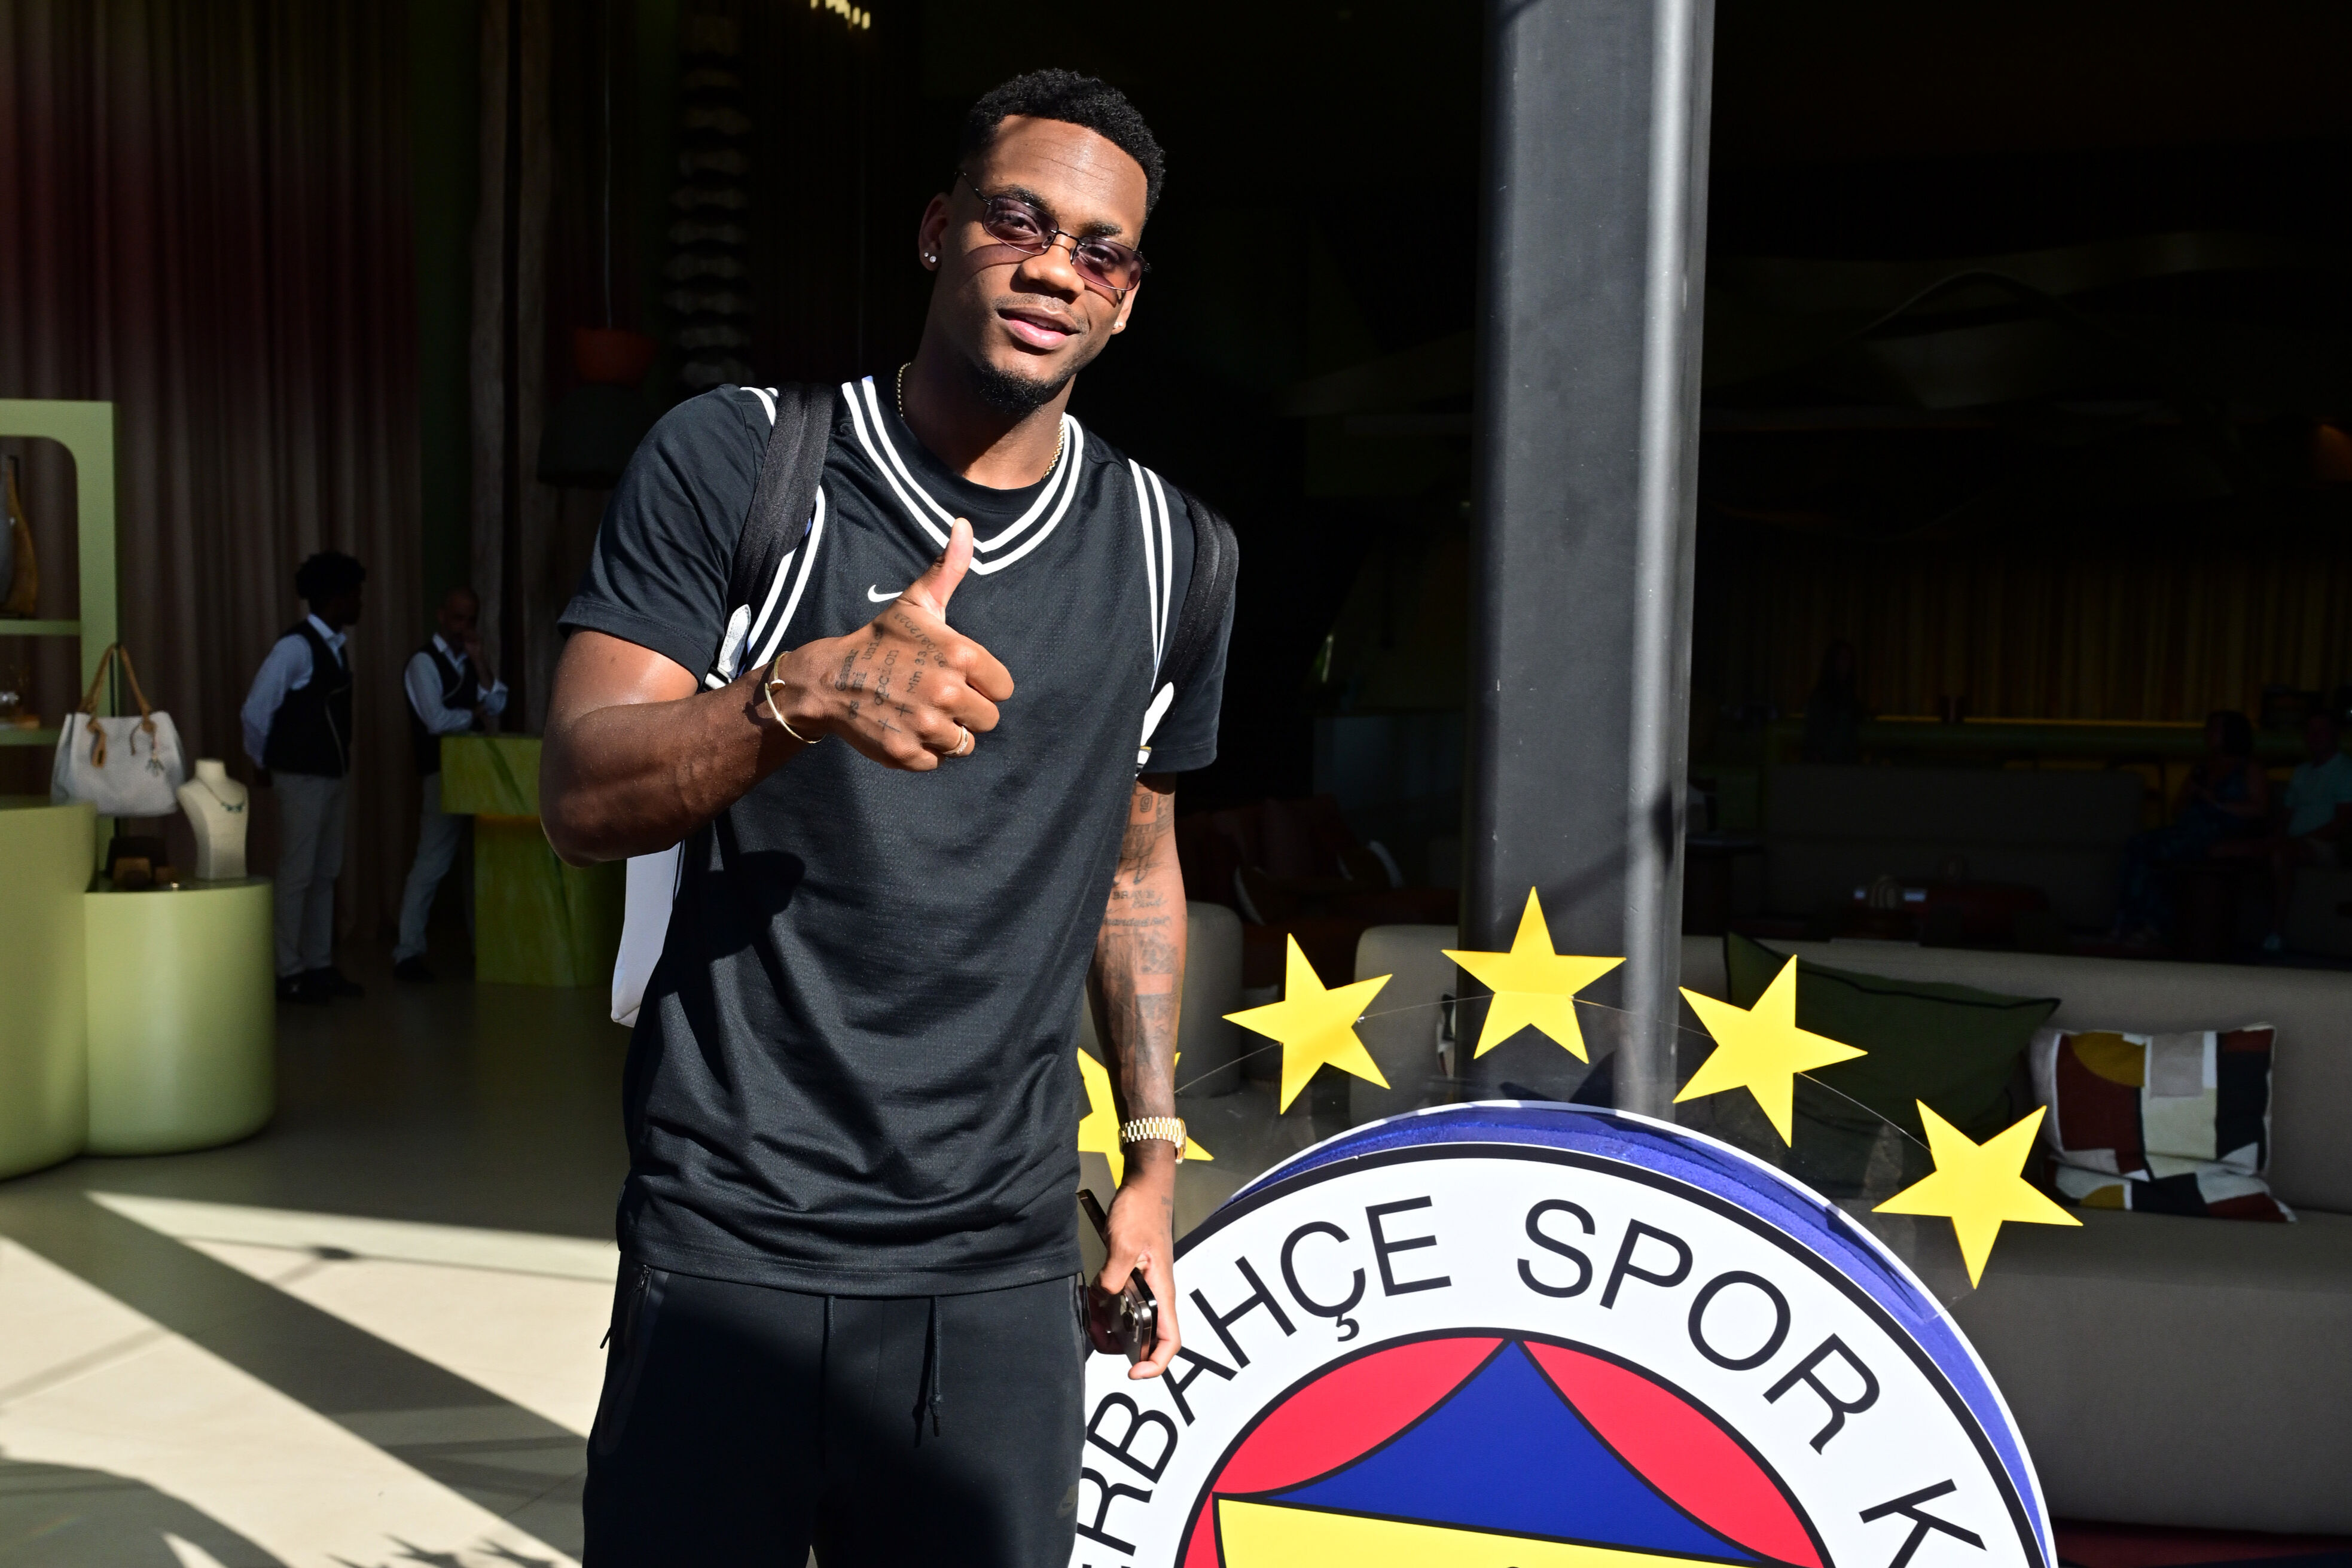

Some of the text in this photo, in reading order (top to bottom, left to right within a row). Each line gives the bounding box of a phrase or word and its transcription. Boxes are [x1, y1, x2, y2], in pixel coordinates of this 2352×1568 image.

[907, 651, 928, 693] Min 33
[1076, 1195, 1451, 1568] RBAHÇE
[1518, 1199, 1880, 1455] SPOR
